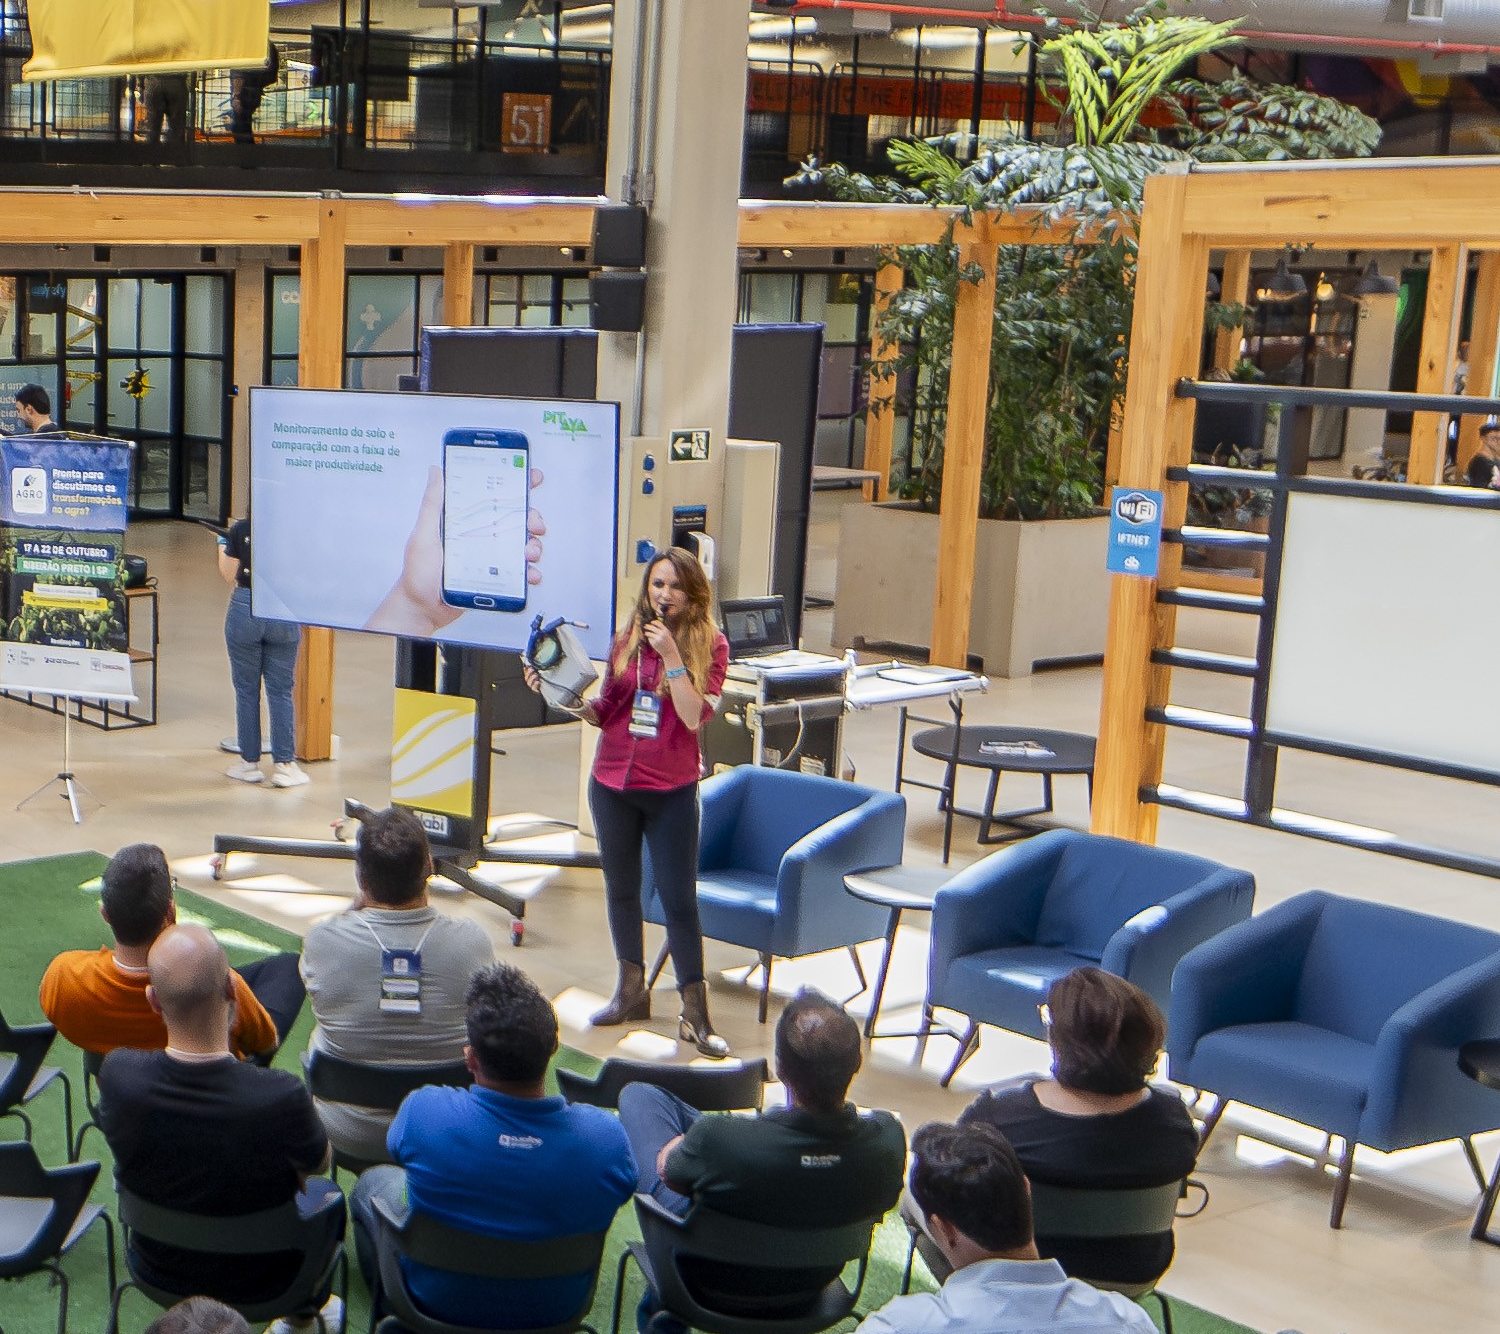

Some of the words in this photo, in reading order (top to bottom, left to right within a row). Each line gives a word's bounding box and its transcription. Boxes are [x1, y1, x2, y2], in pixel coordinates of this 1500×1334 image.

[509, 105, 544, 145] 51
[273, 422, 349, 437] Monitoramento
[272, 440, 328, 454] comparação
[330, 443, 350, 453] com
[353, 445, 359, 454] a
[362, 443, 385, 455] faixa
[387, 445, 400, 456] de
[285, 456, 312, 468] maior
[314, 458, 383, 473] produtividade
[82, 470, 104, 483] para
[16, 489, 43, 499] AGRO
[52, 481, 104, 493] discutirmos
[52, 493, 122, 506] transformações
[24, 543, 32, 552] 17
[33, 543, 40, 553] A
[41, 544, 52, 554] 22
[52, 545, 65, 555] DE
[65, 546, 108, 558] OUTUBRO
[23, 559, 60, 572] RIBEIRÃO
[60, 563, 90, 574] PRETO
[97, 566, 108, 576] SP
[420, 813, 445, 832] abi
